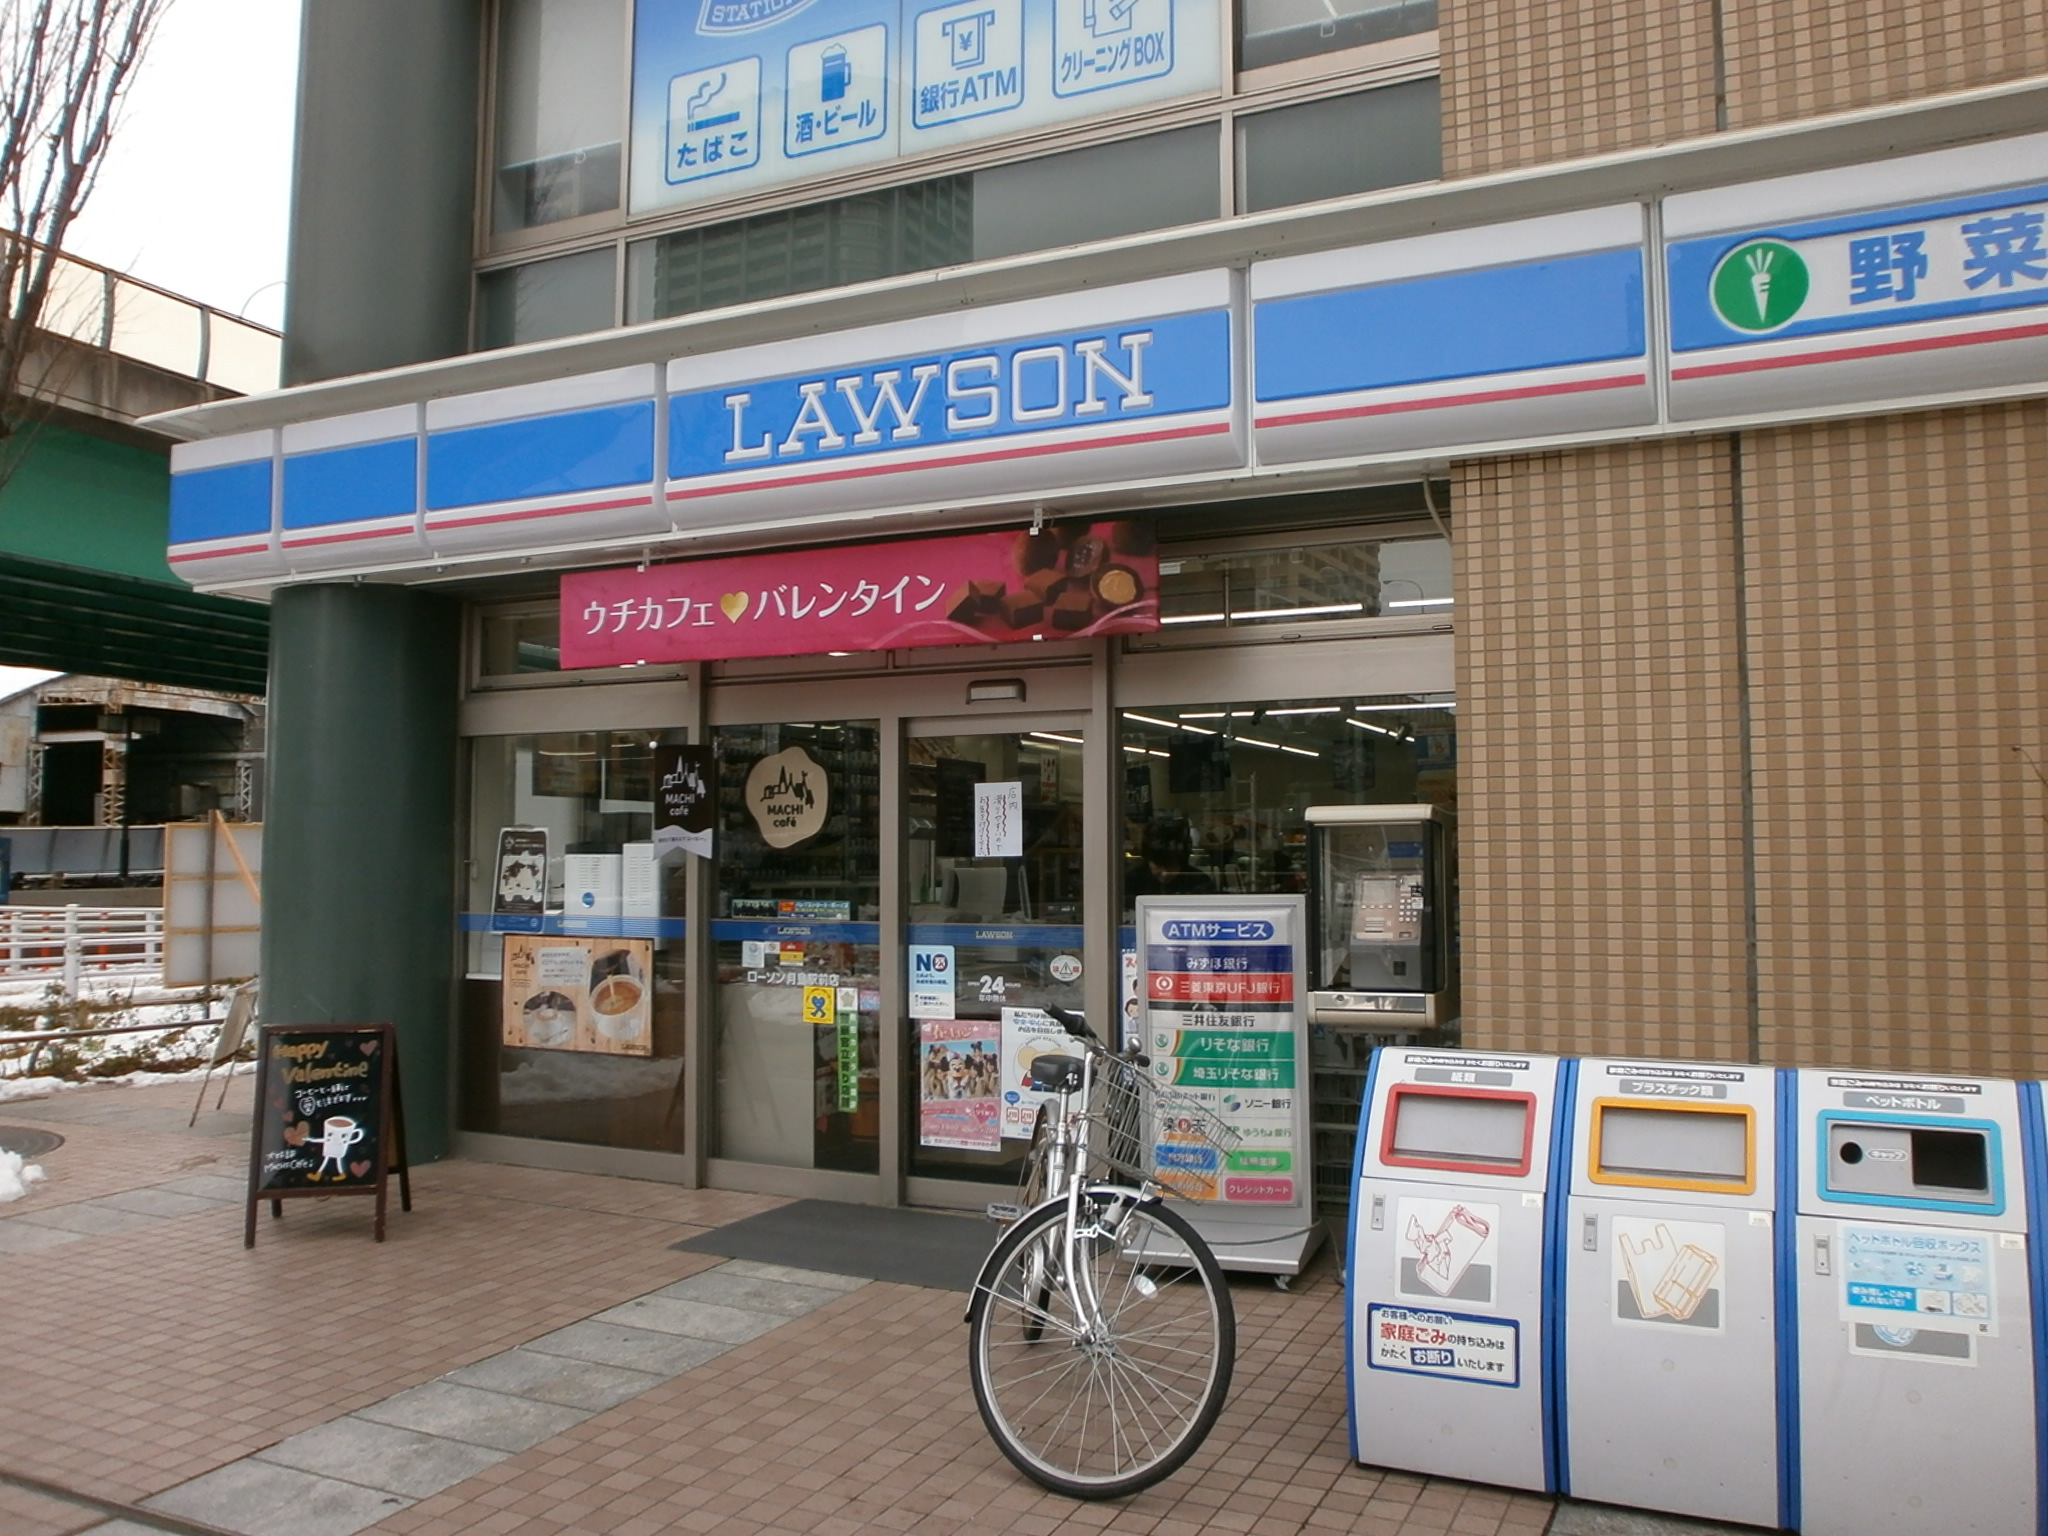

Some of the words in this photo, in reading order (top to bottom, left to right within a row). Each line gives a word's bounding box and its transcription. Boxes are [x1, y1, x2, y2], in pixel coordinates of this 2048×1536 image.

[1060, 32, 1165, 83] クリーニングBOX
[919, 67, 1017, 115] 銀行ATM
[795, 100, 877, 143] 酒・ビール
[677, 131, 749, 168] たばこ
[1849, 212, 2048, 305] 野菜
[724, 329, 1154, 463] LAWSON
[583, 597, 715, 635] ウチカフェ
[753, 575, 946, 621] バレンタイン
[664, 793, 696, 805] MACHI
[669, 804, 690, 817] café
[767, 804, 804, 816] MACHI
[772, 815, 798, 828] café
[975, 930, 1014, 940] LAWSON
[1168, 922, 1268, 938] ATMサービス
[1186, 955, 1249, 970] みずほ銀行
[980, 974, 1005, 995] 24
[1180, 980, 1281, 995] 三菱東京UFJ銀行
[1182, 1014, 1256, 1028] 三井住友銀行
[272, 1040, 330, 1063] Happy
[1200, 1037, 1270, 1053] りそな銀行
[282, 1061, 369, 1085] Valentine
[1193, 1066, 1280, 1082] 埼玉りそな銀行
[1450, 1072, 1477, 1083] 紙類
[1632, 1082, 1715, 1097] プラスチック類
[1244, 1098, 1292, 1110] ソニー銀行
[1866, 1095, 1943, 1110] ペットボトル
[1243, 1127, 1293, 1138] ゆうちょ銀行
[1381, 1309, 1454, 1325] お客様へのお願い
[1380, 1322, 1506, 1351] 家庭ごみの持ち込みは
[1380, 1346, 1408, 1361] かたく
[1412, 1349, 1453, 1366] お断り
[1456, 1356, 1506, 1373] いたします
